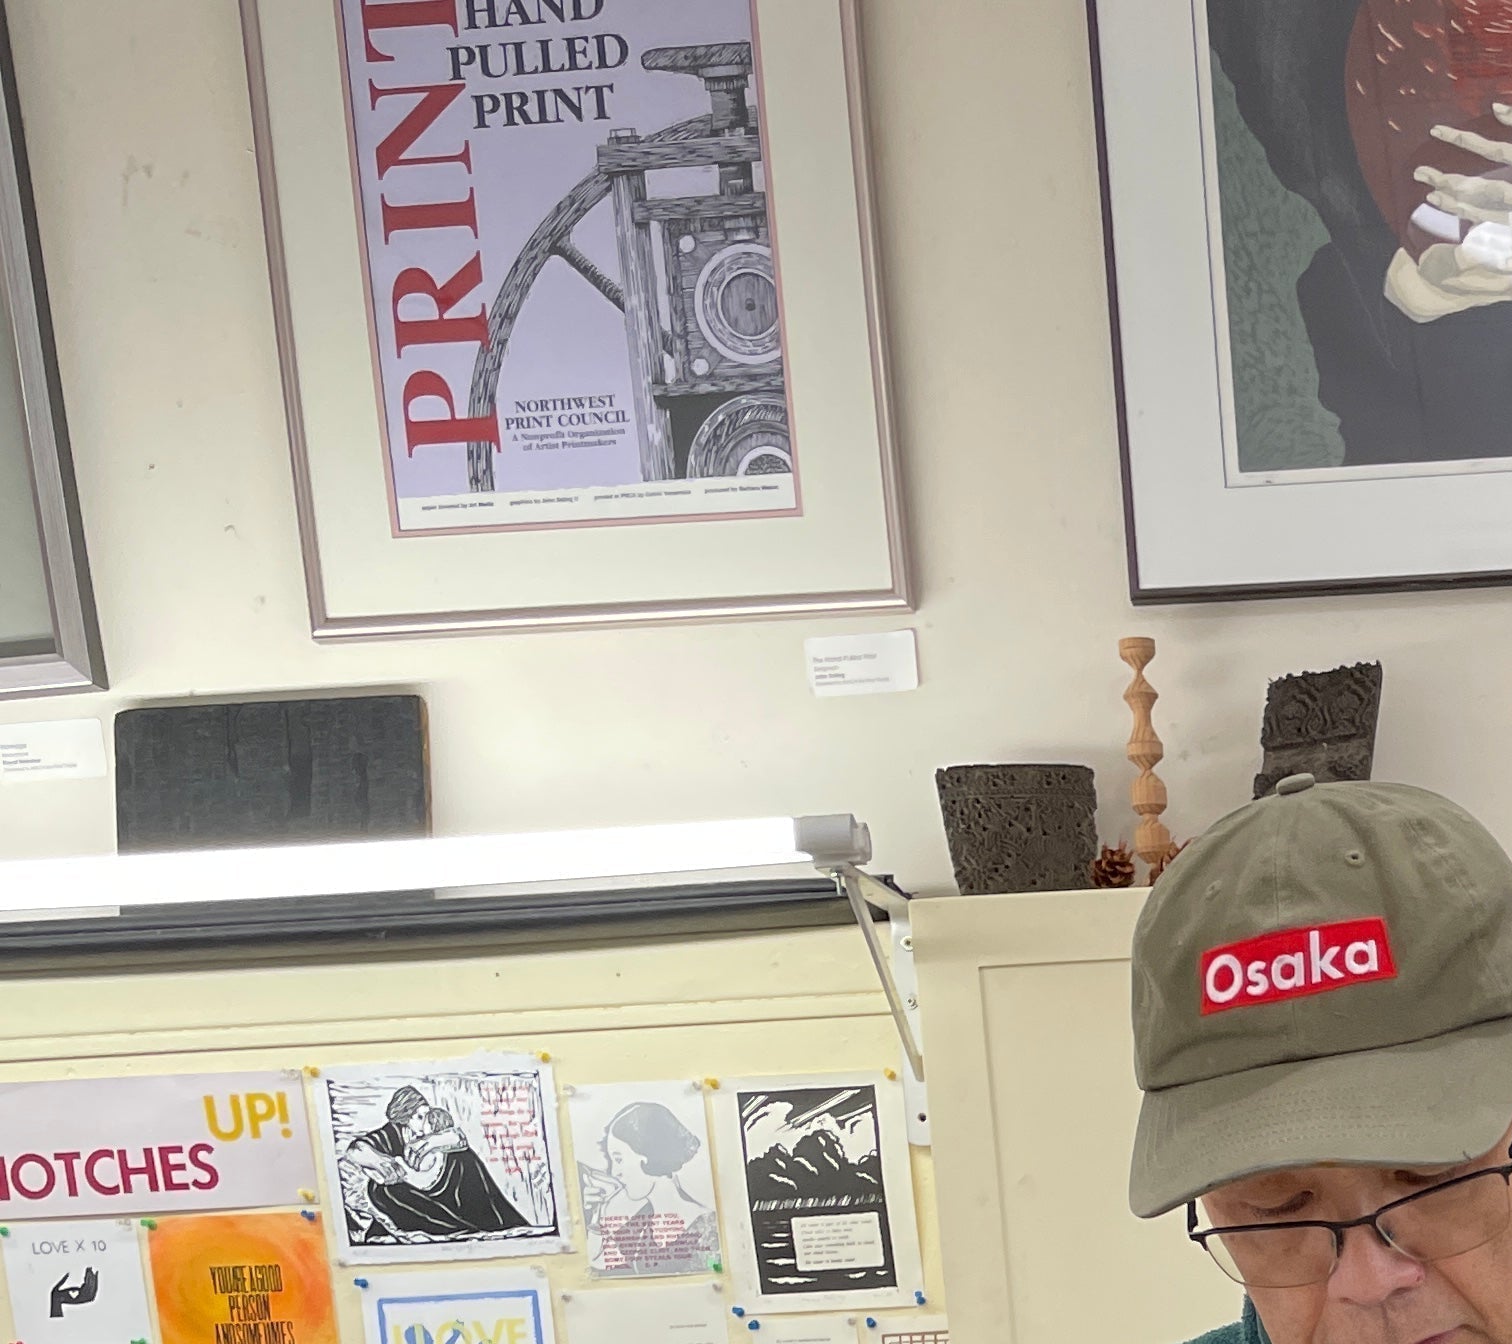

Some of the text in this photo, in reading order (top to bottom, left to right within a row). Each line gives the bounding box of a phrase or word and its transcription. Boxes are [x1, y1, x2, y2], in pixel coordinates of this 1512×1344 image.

[463, 0, 602, 30] HAND
[446, 33, 629, 81] PULLED
[472, 84, 614, 129] PRINT
[515, 394, 615, 413] NORTHWEST
[505, 410, 630, 430] PRINT COUNCIL
[1205, 930, 1379, 1003] Osaka
[203, 1091, 293, 1142] UP!
[32, 1240, 107, 1255] LOVE X 10
[228, 1294, 271, 1322] PERSON
